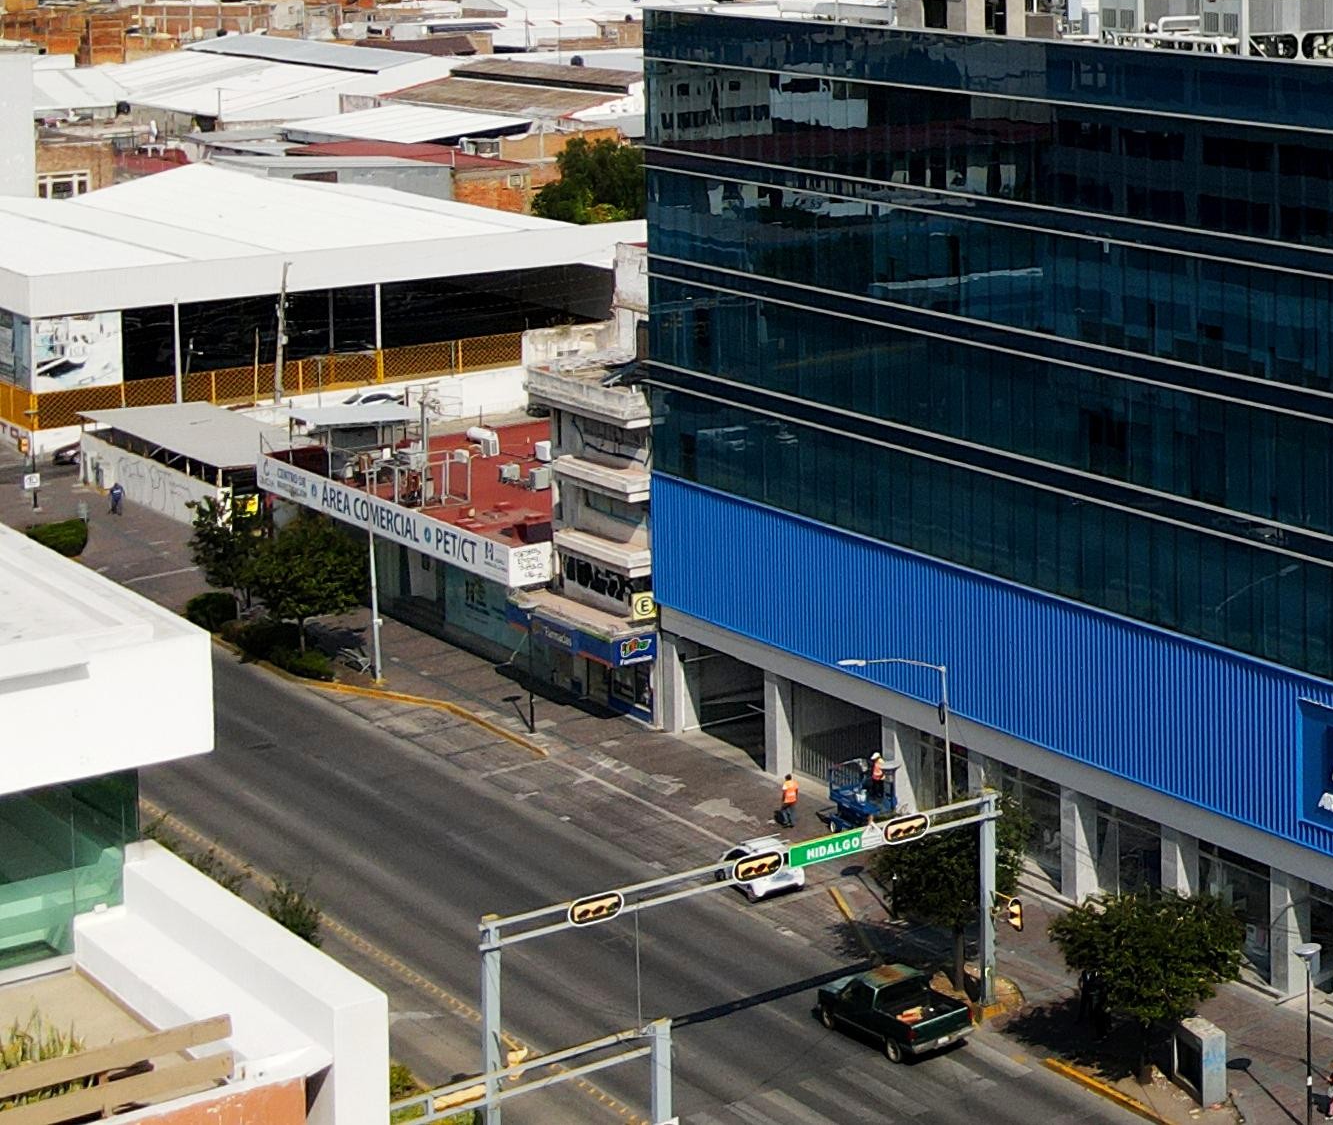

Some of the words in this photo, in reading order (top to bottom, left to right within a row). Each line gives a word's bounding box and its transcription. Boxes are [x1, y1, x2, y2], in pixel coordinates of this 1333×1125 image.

[321, 481, 351, 516] ÁREA
[353, 497, 420, 543] COMERCIAL
[435, 527, 477, 564] PET/CT
[806, 837, 860, 860] HIDALGO
